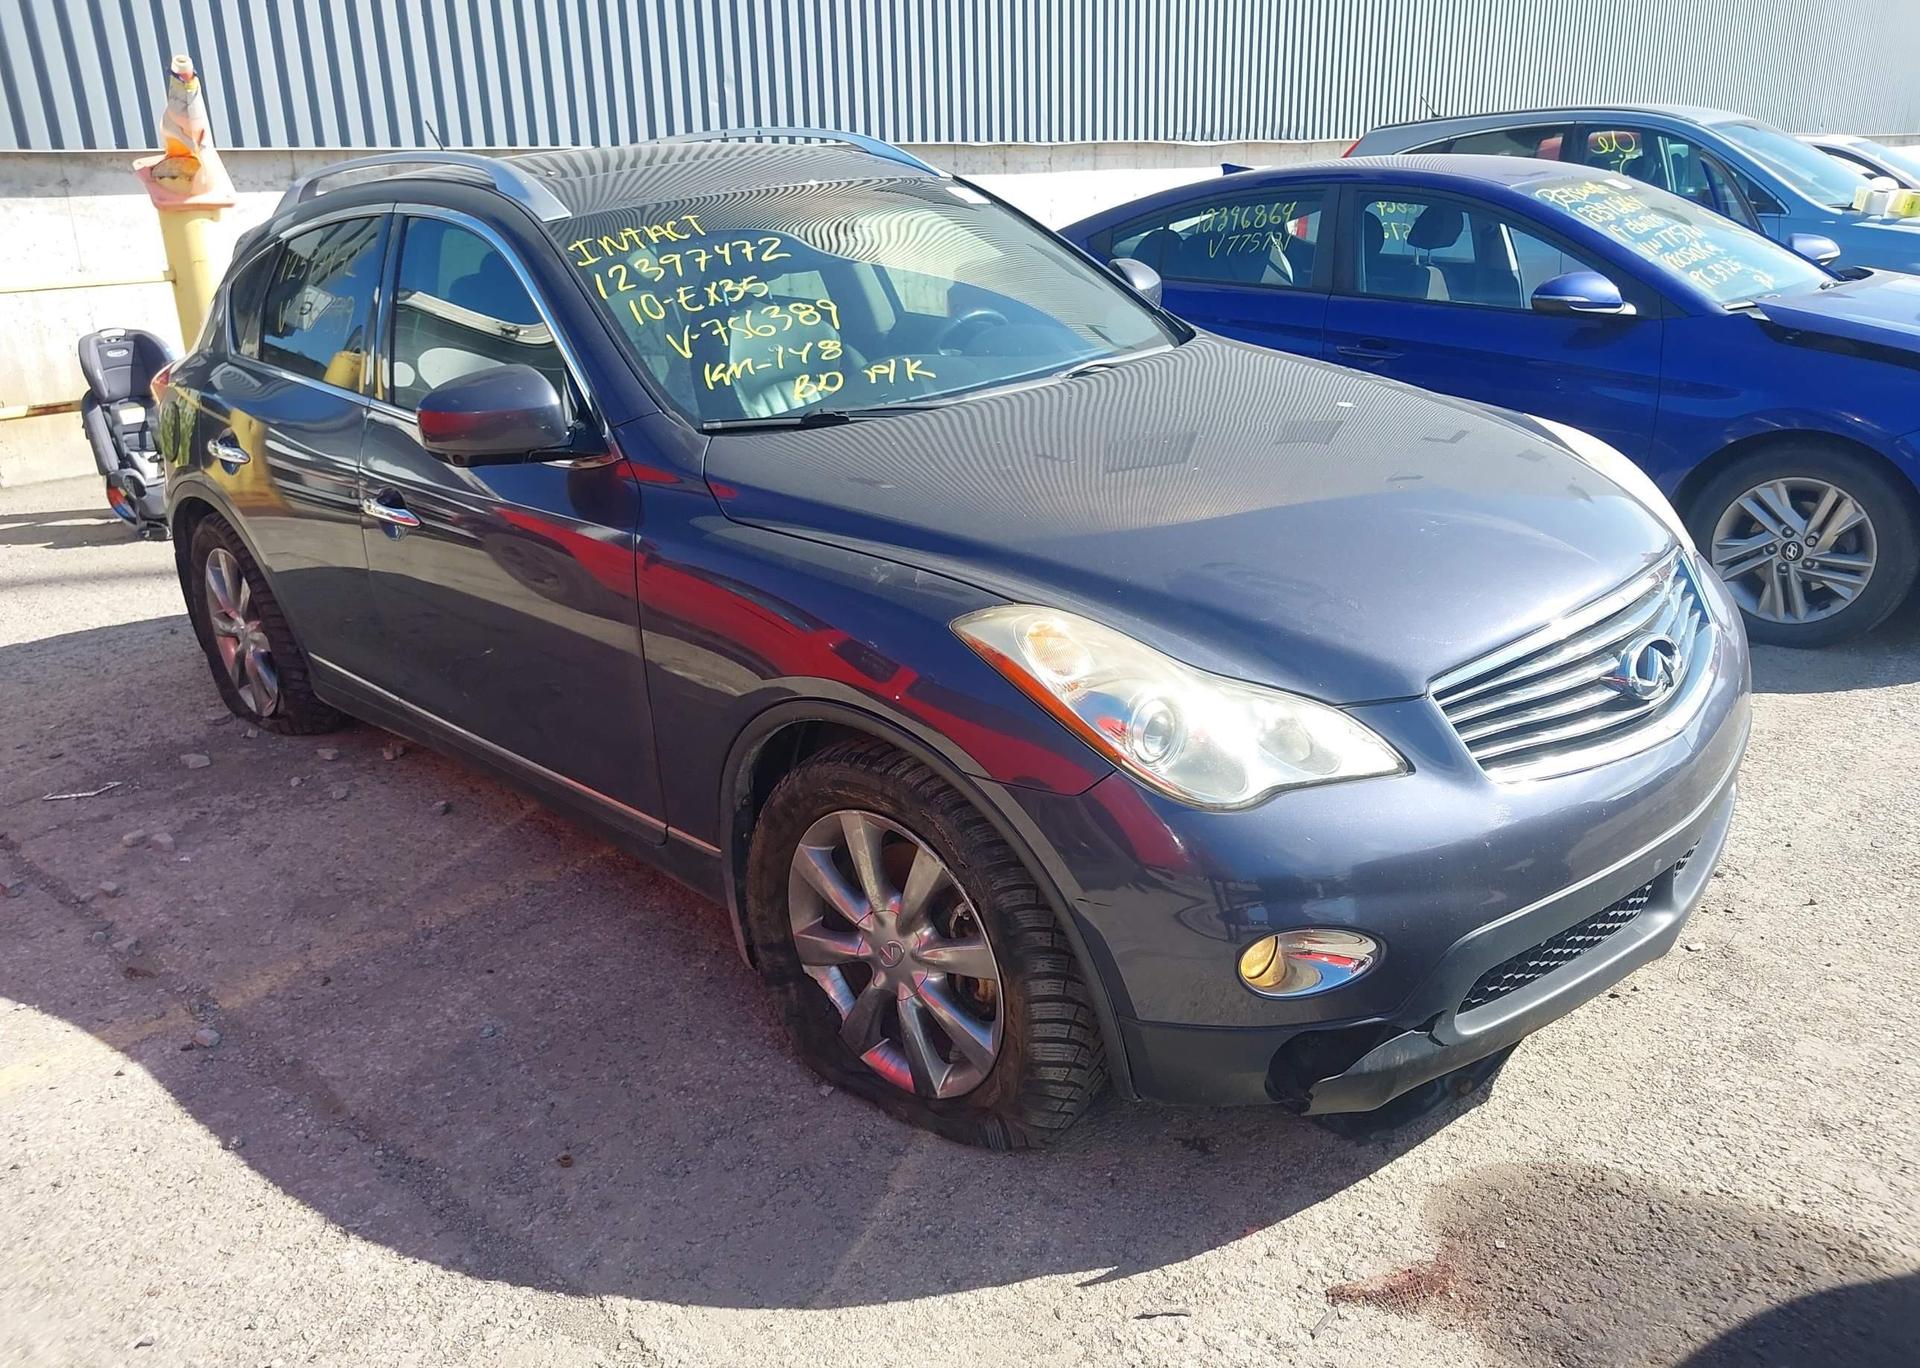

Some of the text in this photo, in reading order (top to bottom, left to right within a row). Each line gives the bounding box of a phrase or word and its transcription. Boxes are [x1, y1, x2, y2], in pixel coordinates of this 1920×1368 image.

[568, 215, 706, 267] INTACT
[595, 237, 792, 300] 12397472
[629, 275, 769, 326] 10-EX35
[666, 299, 841, 360] V-756389
